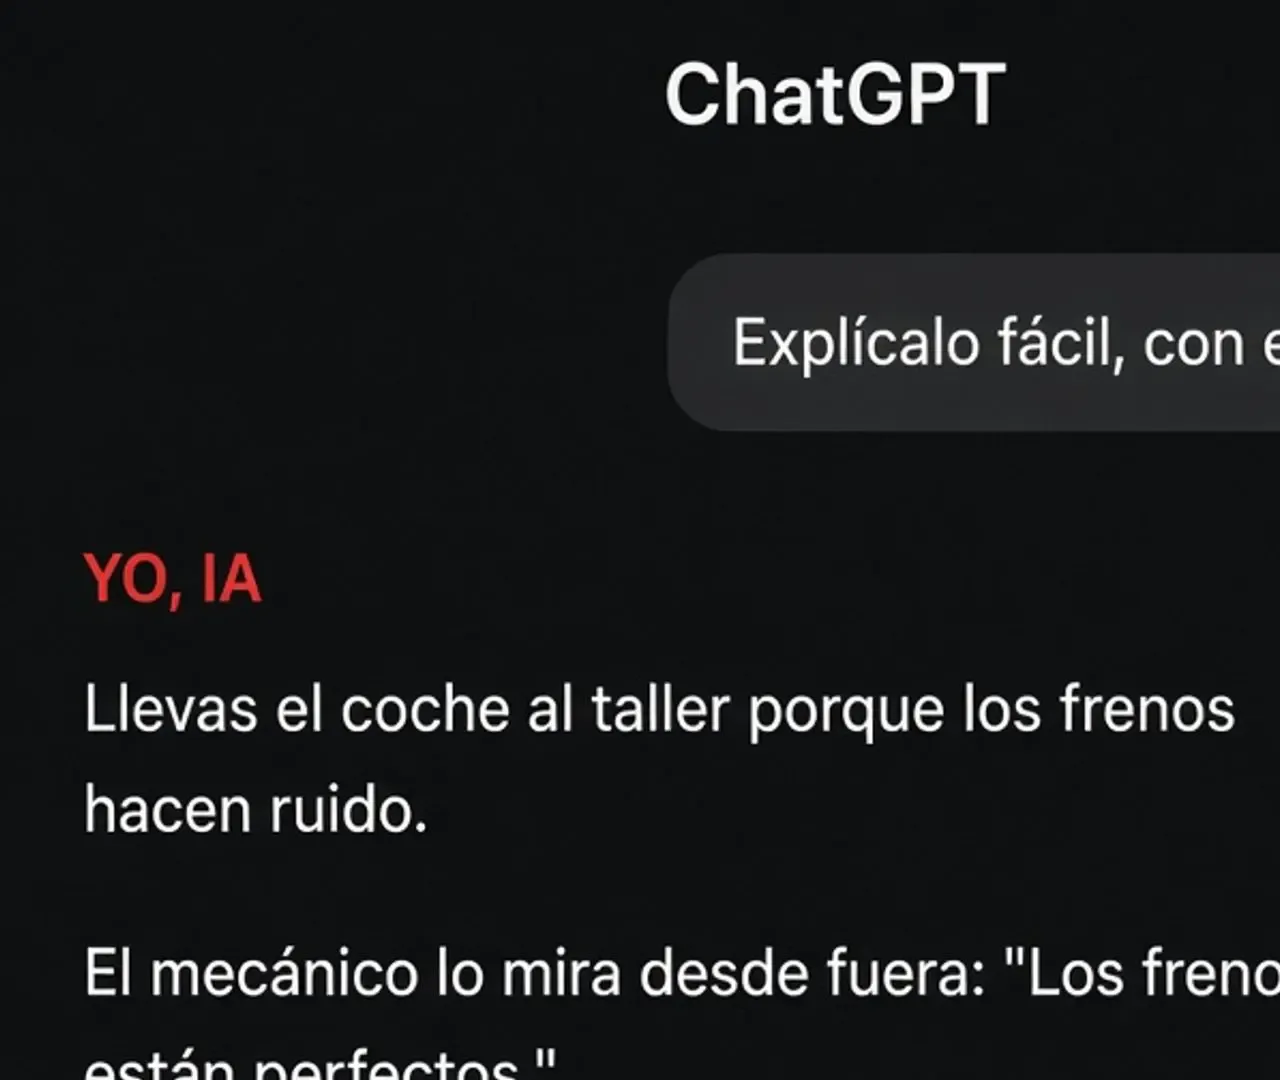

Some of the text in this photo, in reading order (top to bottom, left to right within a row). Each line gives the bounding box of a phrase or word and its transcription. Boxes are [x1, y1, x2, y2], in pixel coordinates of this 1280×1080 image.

[666, 60, 1007, 126] ChatGPT
[735, 314, 980, 379] Explícalo
[997, 314, 1125, 377] fácil,
[1144, 328, 1244, 366] con
[83, 551, 262, 613] YO, IA
[87, 681, 1236, 745] Llevas el coche al taller porque los frenos
[86, 781, 426, 833] hacen ruido.
[87, 946, 130, 996] El
[152, 944, 419, 997] mecánico
[438, 945, 484, 997] lo
[503, 945, 621, 997] mira
[640, 945, 809, 997] desde
[826, 945, 984, 997] fuera:
[1005, 945, 1124, 997] "Los
